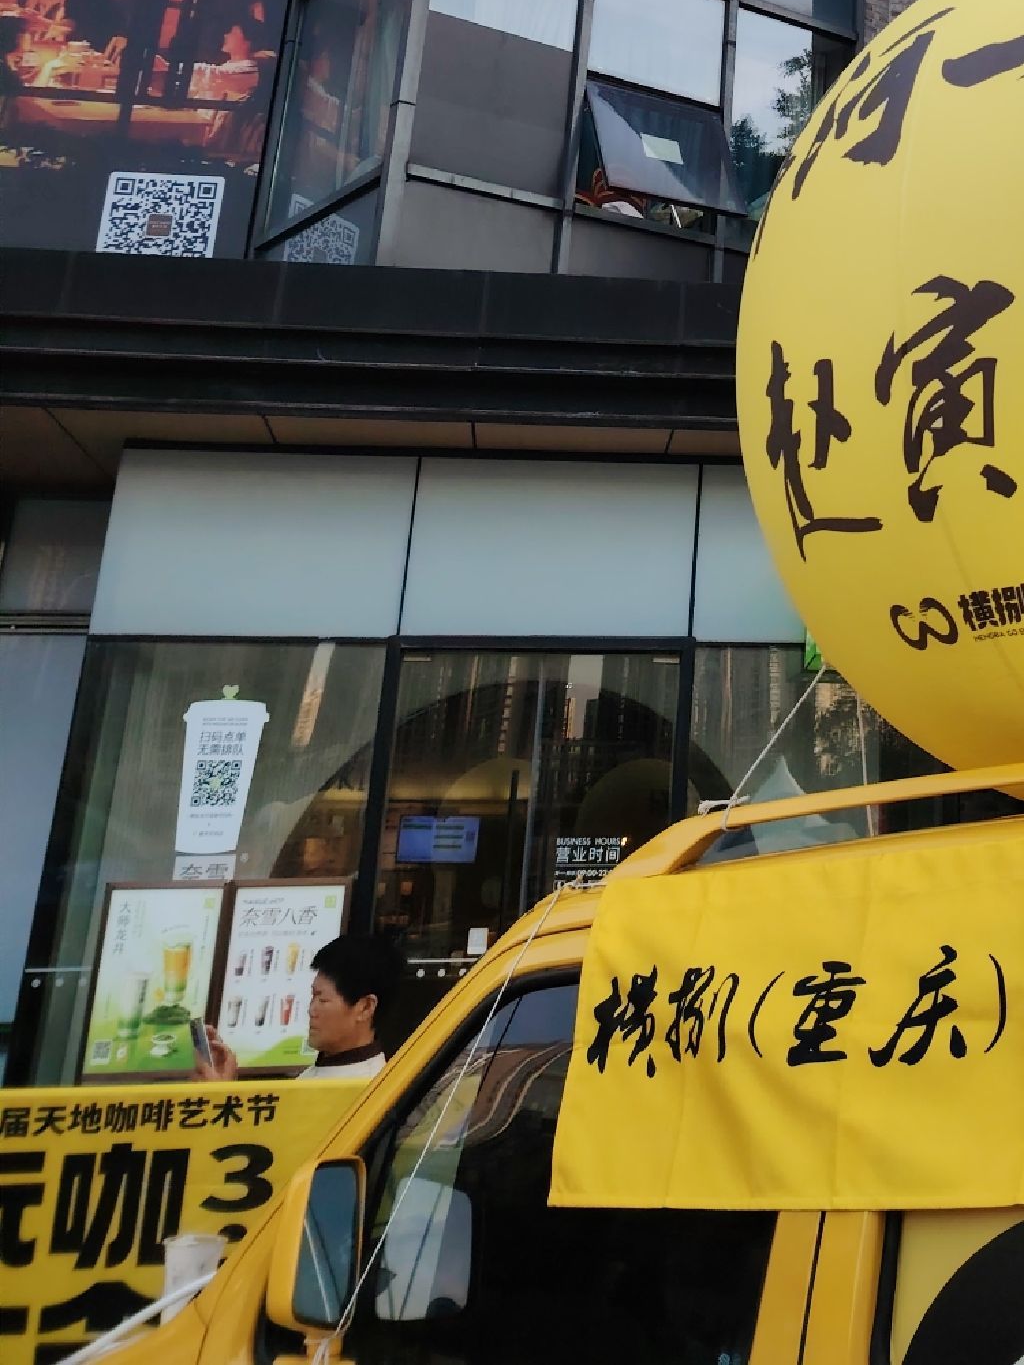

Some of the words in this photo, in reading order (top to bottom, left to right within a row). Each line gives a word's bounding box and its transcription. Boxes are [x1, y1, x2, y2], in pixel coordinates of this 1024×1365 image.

[556, 837, 591, 846] BUSINESS
[594, 837, 621, 846] HOURS
[556, 846, 620, 863] 营业时间
[0, 1093, 280, 1138] 届天地咖啡艺术节
